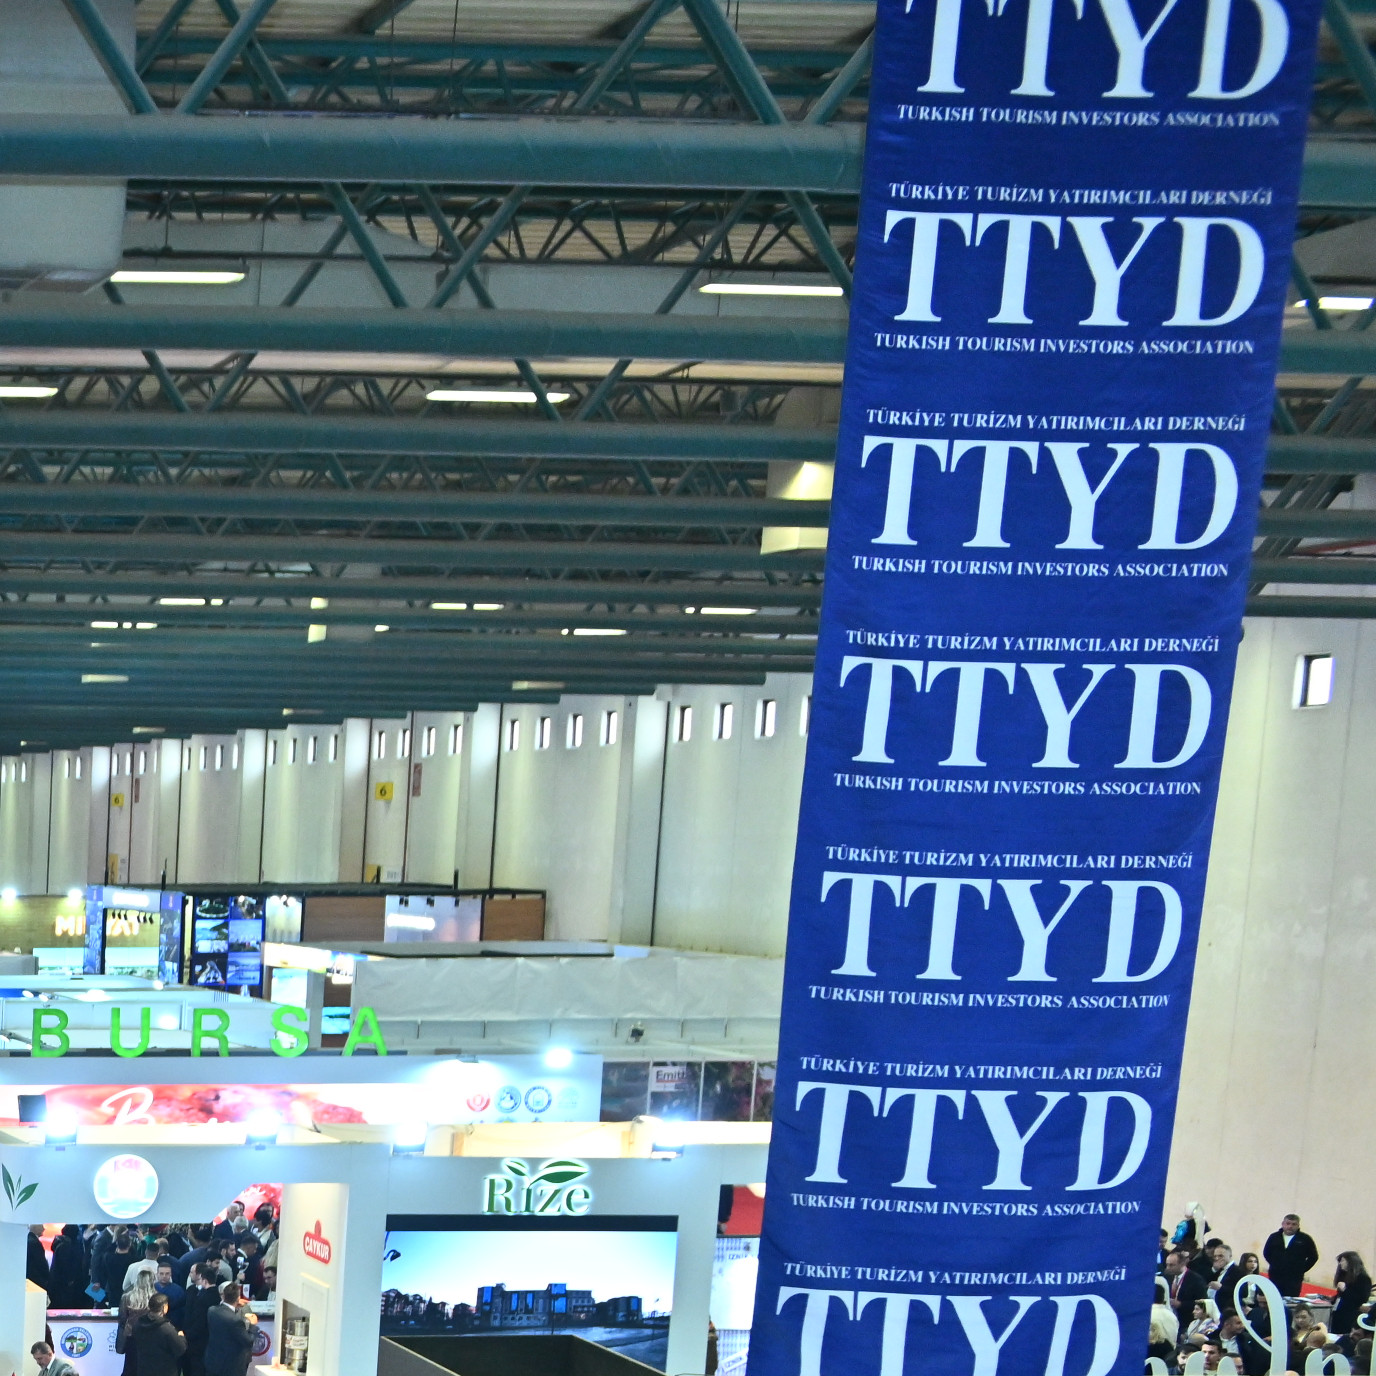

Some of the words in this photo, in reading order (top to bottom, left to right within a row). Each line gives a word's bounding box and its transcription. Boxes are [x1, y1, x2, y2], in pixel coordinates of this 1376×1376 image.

[905, 0, 1289, 99] TTYD
[898, 104, 974, 122] TURKISH
[979, 107, 1057, 126] TOURISM
[1062, 111, 1159, 127] INVESTORS
[1164, 111, 1279, 128] ASSOCIATION
[889, 182, 969, 200] TÜRKİYE
[974, 184, 1044, 203] TURİZM
[1048, 188, 1186, 205] YATIRIMCILARI
[1190, 187, 1273, 206] DERNEĞİ
[884, 210, 1265, 326] TTYD
[874, 332, 950, 350] TURKISH
[955, 335, 1035, 353] TOURISM
[1040, 338, 1134, 355] INVESTORS
[1138, 339, 1254, 355] ASSOCIATION
[866, 408, 945, 426] TÜRKİYE
[951, 411, 1022, 428] TURİZM
[1027, 415, 1163, 431] YATIRIMCILARI
[1167, 415, 1246, 432] DERNEĞİ
[861, 435, 1239, 550] TTYD
[852, 556, 927, 573] TURKISH
[931, 558, 1013, 576] TOURISM
[1018, 561, 1109, 577] INVESTORS
[1114, 561, 1228, 578] ASSOCIATION
[846, 629, 920, 647] TÜRKİYE
[924, 631, 997, 649] TURİZM
[1003, 636, 1139, 652] YATIRIMCILARI
[1144, 635, 1219, 652] DERNEĞİ
[839, 656, 1212, 769] TTYD
[834, 773, 904, 789] TURKISH
[908, 776, 988, 793] TOURISM
[993, 779, 1085, 794] INVESTORS
[1090, 779, 1201, 795] ASSOCIATION
[826, 845, 899, 864] TÜRKİYE
[903, 849, 974, 866] TURİZM
[979, 853, 1116, 868] YATIRIMCILARI
[1120, 852, 1193, 868] DERNEĞİ
[821, 871, 1183, 983] TTYD
[809, 985, 884, 1003] TURKISH
[888, 989, 963, 1006] TOURISM
[968, 992, 1063, 1008] INVESTORS
[1067, 993, 1170, 1008] ASSOCIATION
[32, 1006, 388, 1058] BURSA
[800, 1056, 879, 1074] TÜRKİYE
[883, 1059, 949, 1078] TURİZM
[954, 1064, 1092, 1080] YATIRIMCILARI
[1096, 1063, 1162, 1080] DERNEĞİ
[795, 1081, 1152, 1191] TTYD
[791, 1192, 856, 1209] TURKISH
[860, 1196, 938, 1214] TOURISM
[943, 1201, 1038, 1217] INVESTORS
[1043, 1201, 1141, 1217] ASSOCIATION
[304, 1236, 330, 1260] ÇAYKUR
[784, 1261, 851, 1279] TÜRKİYE
[855, 1265, 924, 1283] TURİZM
[928, 1269, 1063, 1285] YATIRIMCILARI
[1067, 1265, 1126, 1284] DERNEĞİ
